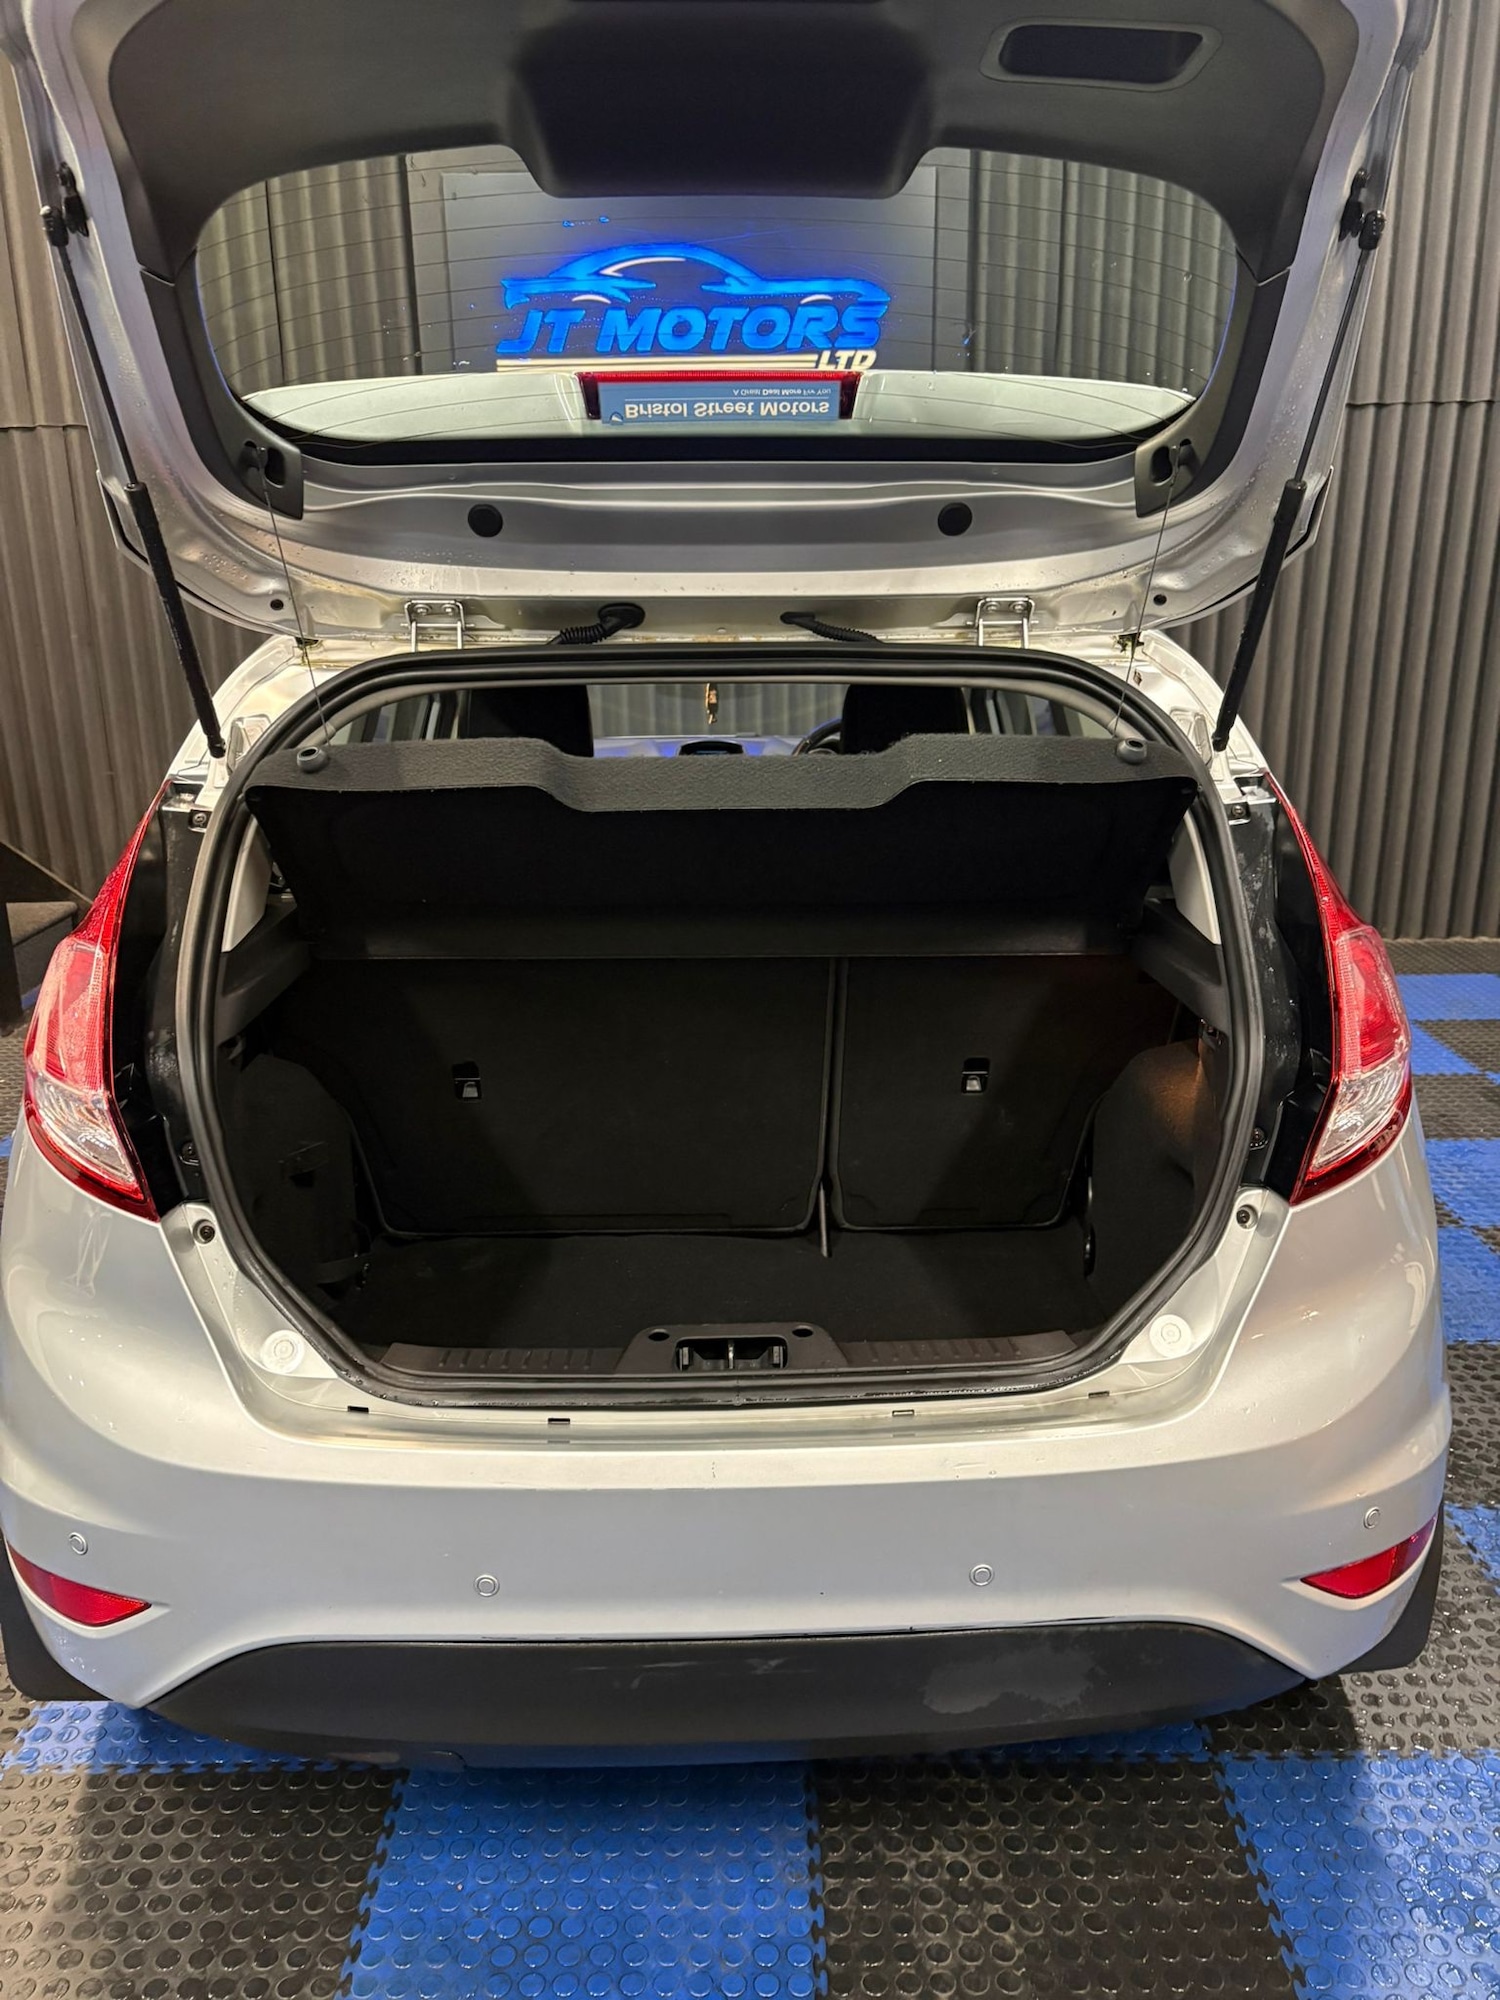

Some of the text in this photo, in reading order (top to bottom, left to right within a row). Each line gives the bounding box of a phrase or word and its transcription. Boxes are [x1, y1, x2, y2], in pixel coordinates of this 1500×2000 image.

[496, 304, 890, 353] JT MOTORS
[817, 349, 877, 371] LTD
